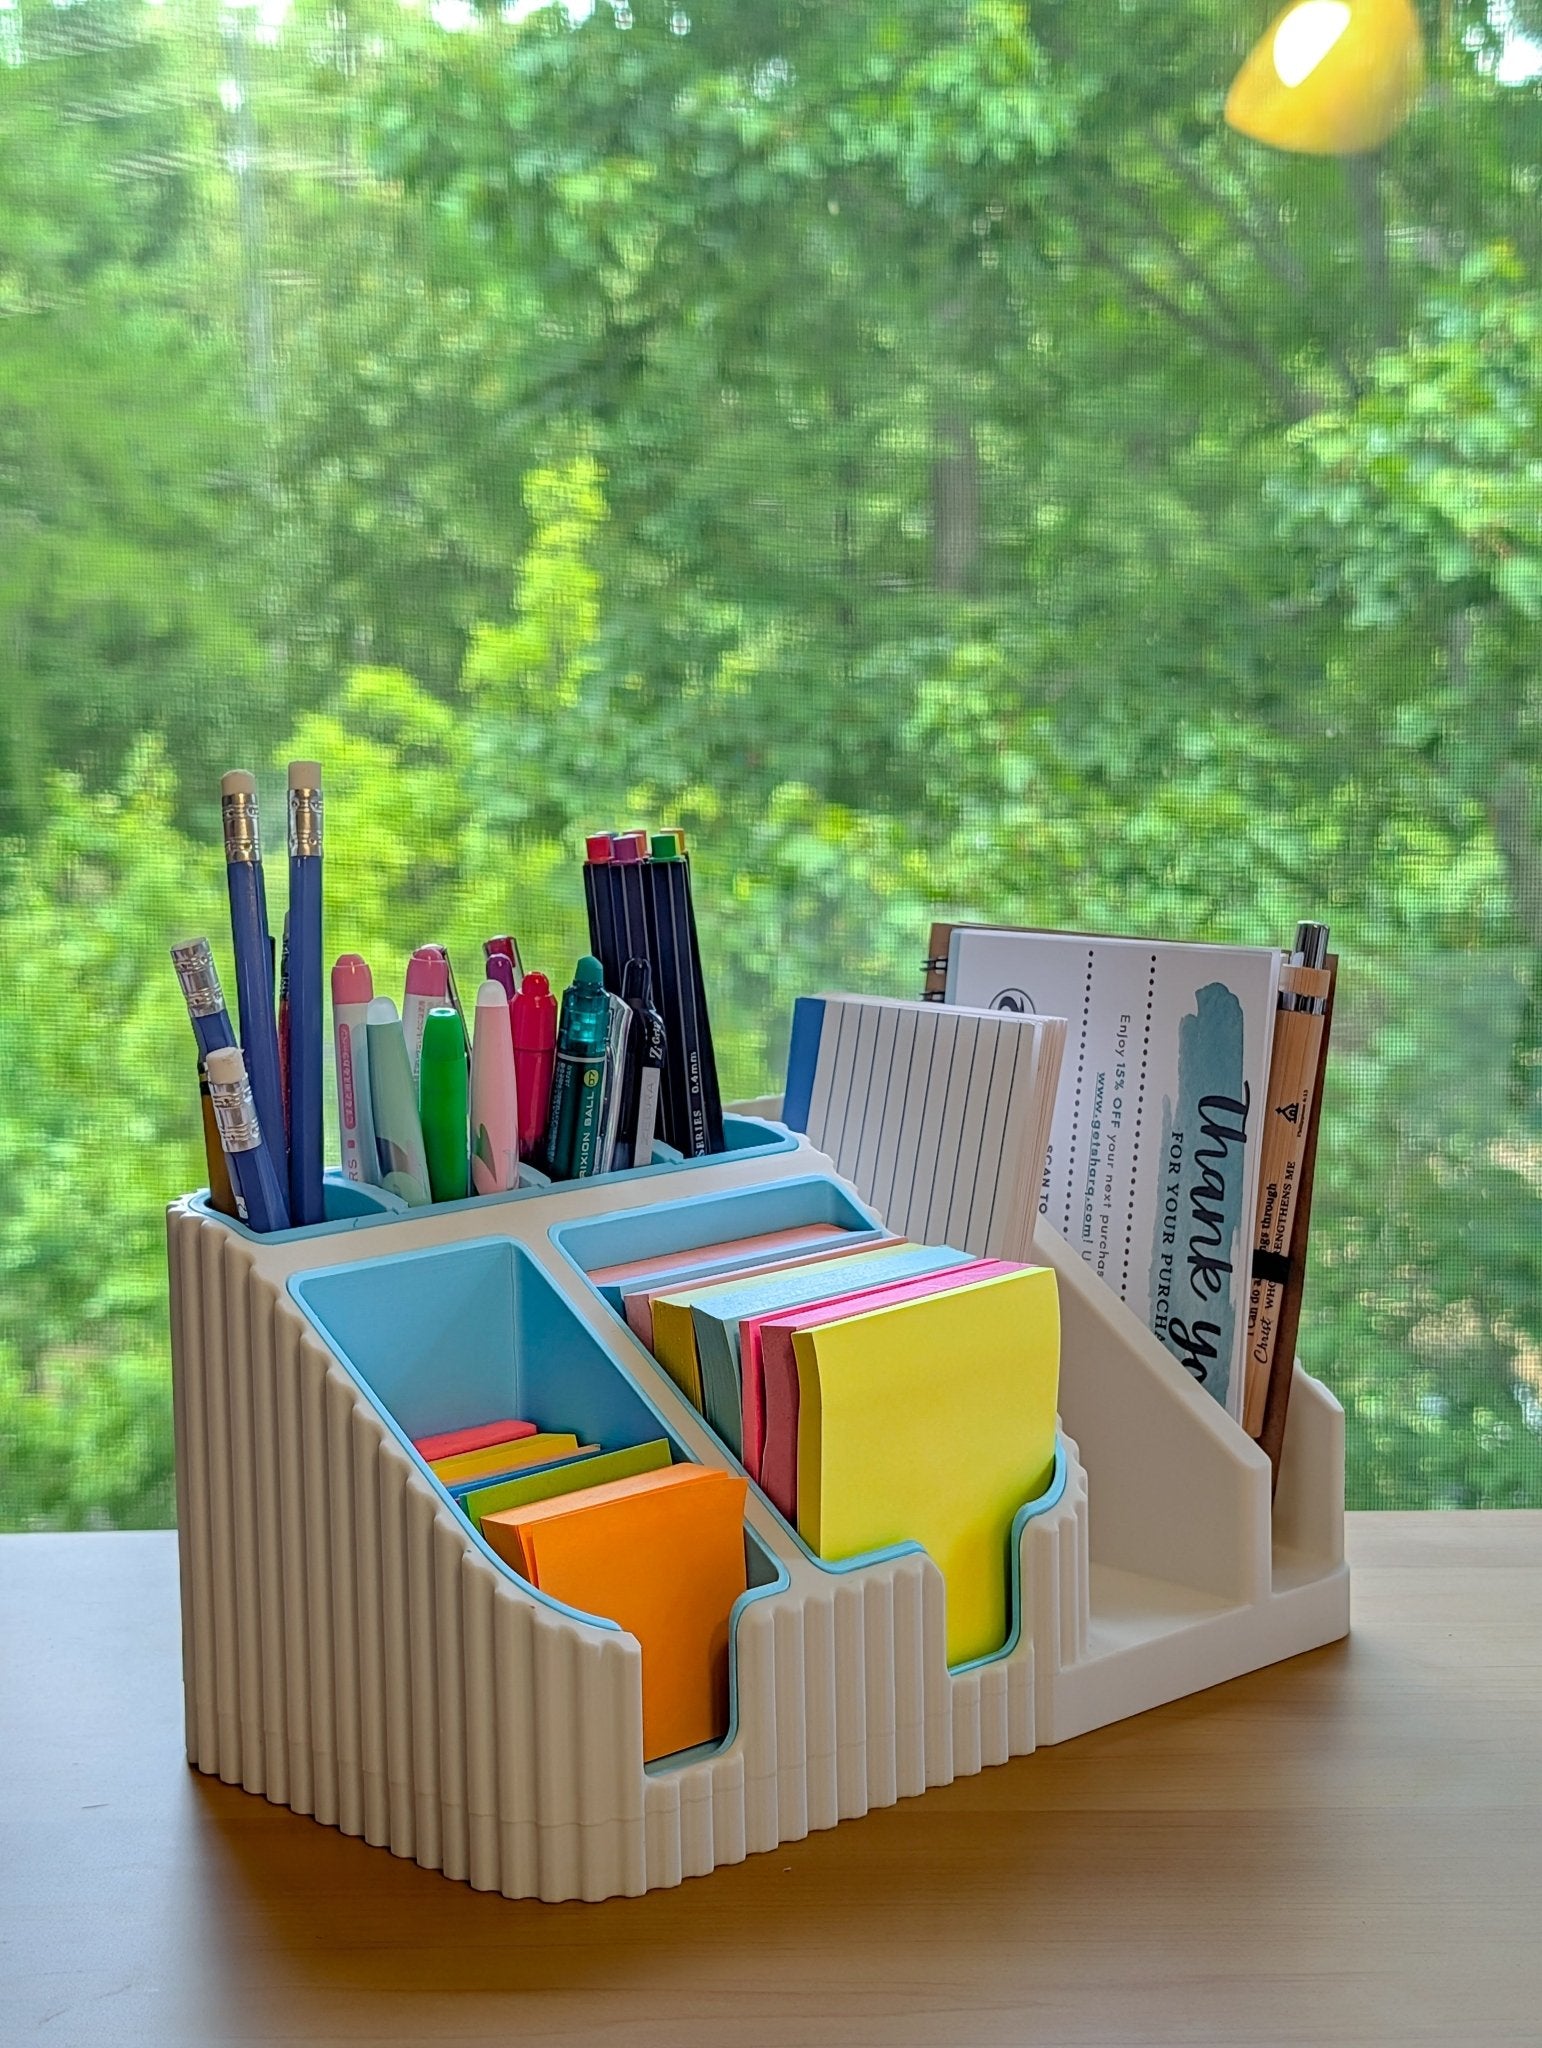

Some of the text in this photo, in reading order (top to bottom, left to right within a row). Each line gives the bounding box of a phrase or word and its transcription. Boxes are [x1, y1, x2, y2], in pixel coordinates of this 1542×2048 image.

[1115, 1014, 1131, 1057] Enjoy
[1114, 1063, 1126, 1091] 15%
[584, 1091, 595, 1126] BALL
[690, 1051, 705, 1158] SERIES 0.4mm
[1111, 1097, 1122, 1128] OFF
[1106, 1134, 1117, 1168] your
[1168, 1132, 1184, 1174] FOR
[1039, 1193, 1049, 1214] TO
[1103, 1174, 1113, 1208] next
[1187, 1080, 1250, 1301] Thank
[1162, 1183, 1180, 1244] YOUR
[1250, 1289, 1261, 1304] do
[1260, 1183, 1278, 1229] through
[1253, 1316, 1271, 1364] Christ
[1285, 1161, 1296, 1180] ME
